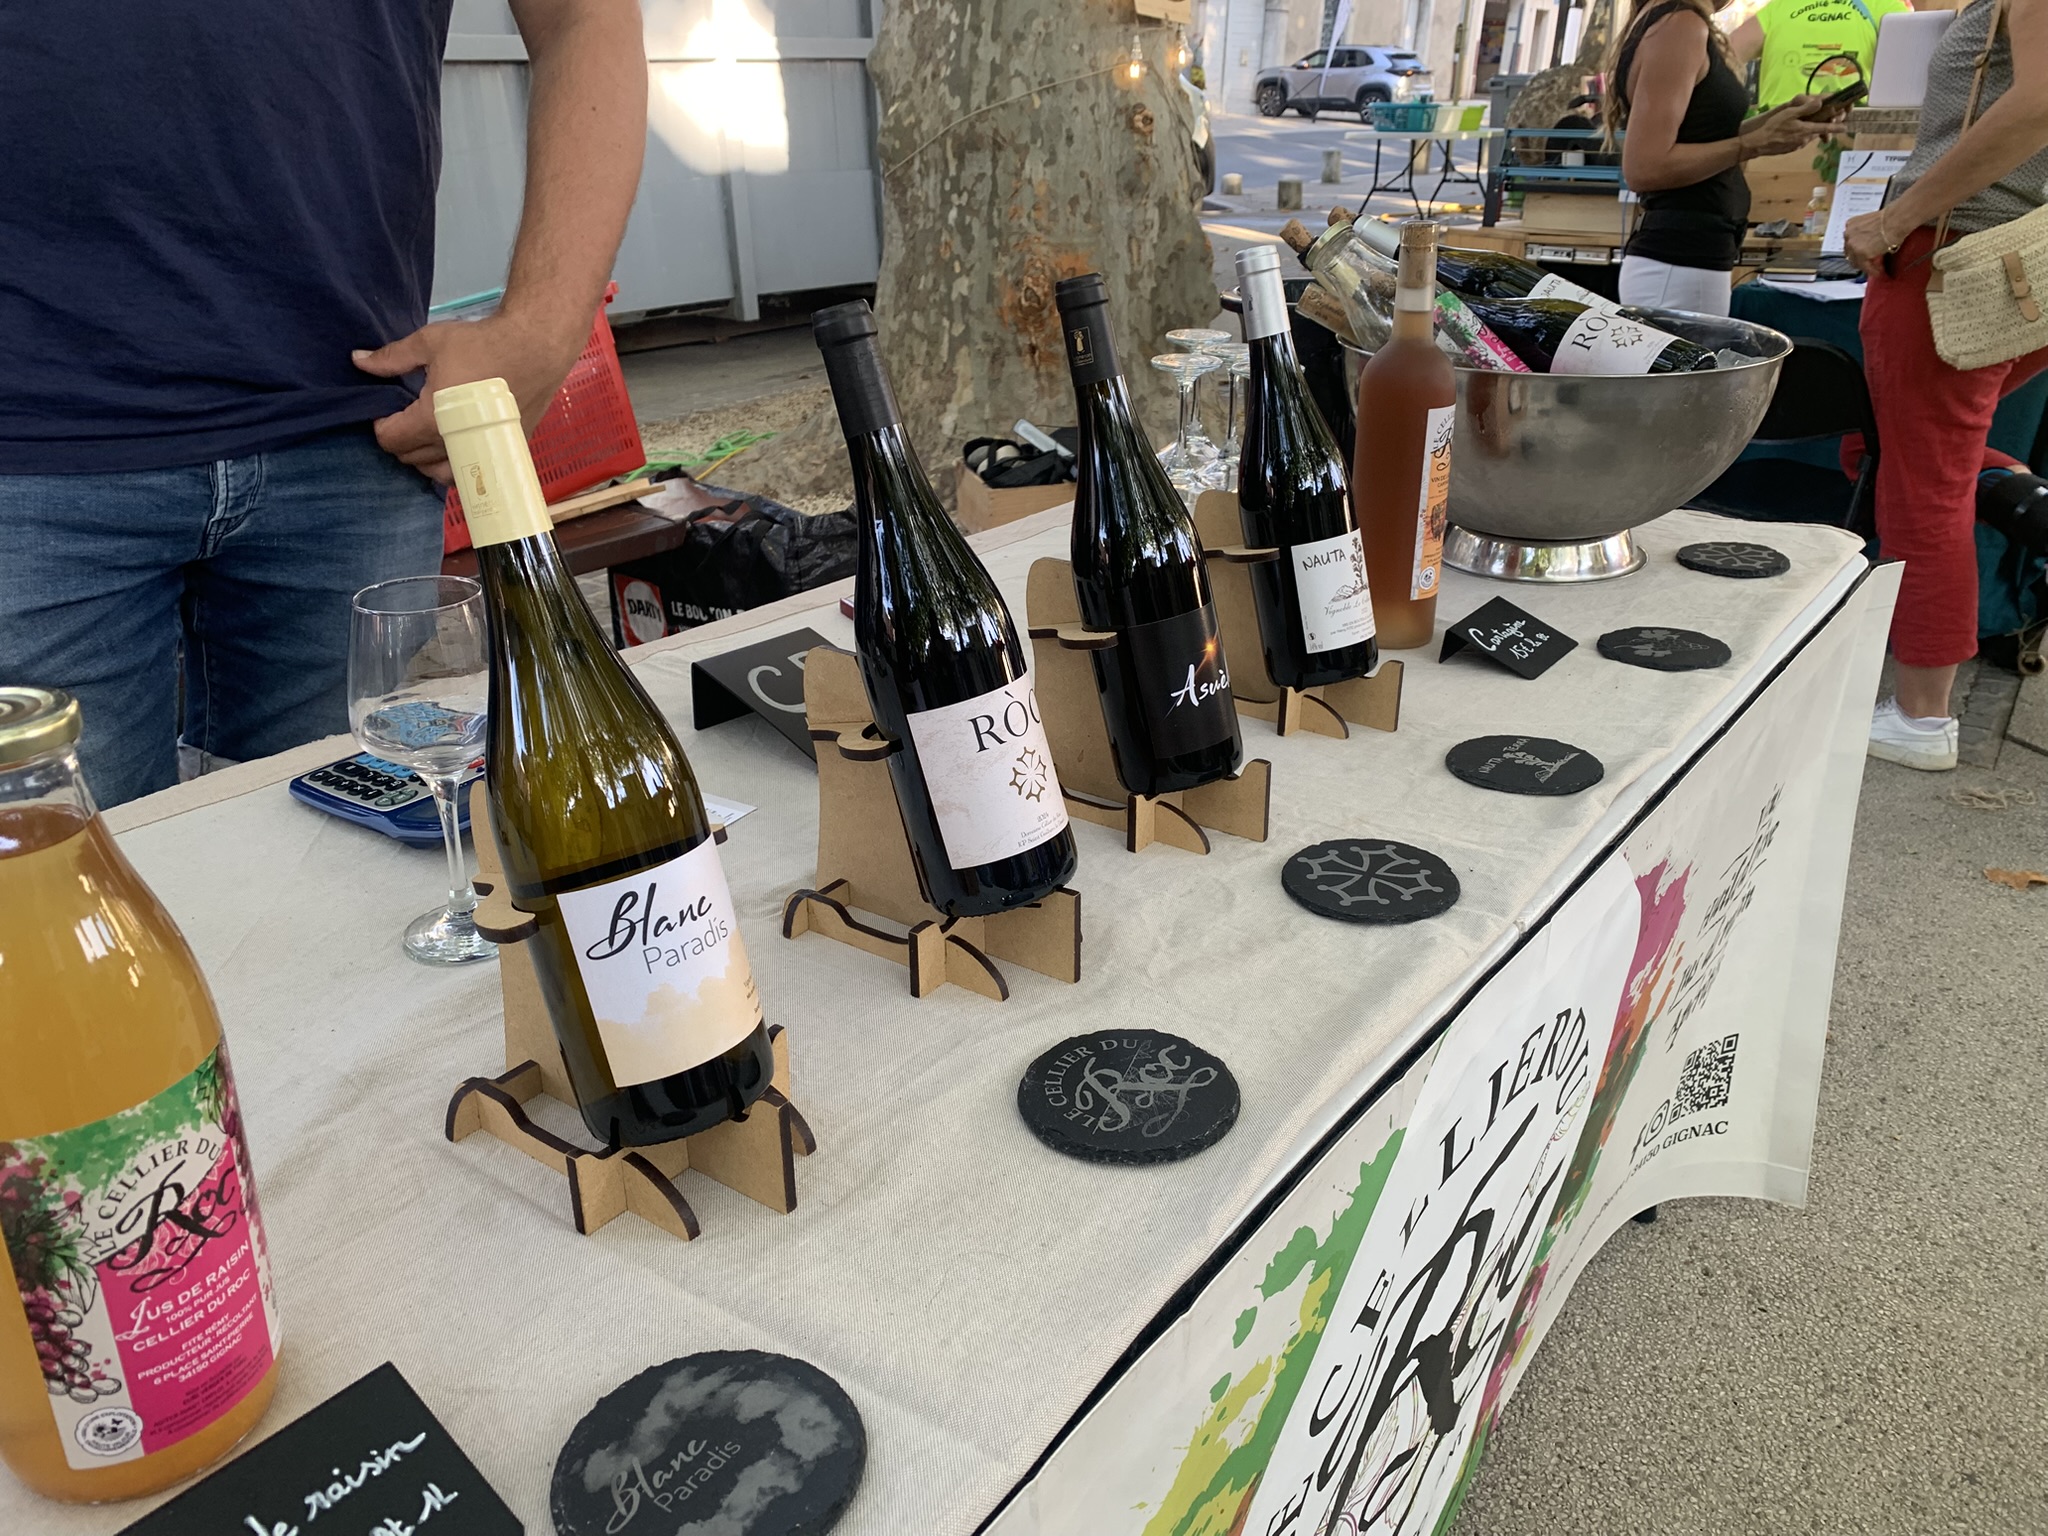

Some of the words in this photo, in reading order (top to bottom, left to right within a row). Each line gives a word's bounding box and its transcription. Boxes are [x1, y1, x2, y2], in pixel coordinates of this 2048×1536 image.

[1808, 12, 1851, 21] GIGNAC
[1302, 549, 1346, 571] NAUTA
[628, 599, 662, 623] DARTY
[671, 601, 684, 617] LE
[586, 883, 713, 960] Blanc
[642, 917, 729, 974] Paradis
[1099, 1038, 1139, 1051] DU
[1044, 1045, 1095, 1107] CELLIER
[1063, 1107, 1096, 1129] LE
[1662, 1121, 1729, 1150] GIGNAC
[195, 1137, 221, 1161] DU
[97, 1139, 189, 1220] CELLIER
[94, 1227, 118, 1256] LE
[177, 1282, 203, 1306] DE
[205, 1240, 249, 1287] RAISIN
[132, 1311, 205, 1352] CELLIER
[207, 1292, 226, 1314] DU
[227, 1268, 251, 1297] ROC
[166, 1306, 192, 1324] 100%
[194, 1289, 214, 1307] PUR
[213, 1276, 230, 1293] JUS
[137, 1336, 213, 1380] PRODUCTEUR
[178, 1361, 209, 1383] 34150
[210, 1333, 243, 1363] GIGNAC
[181, 1331, 204, 1351] FITE
[154, 1376, 162, 1385] 6
[163, 1358, 200, 1382] PLACE
[304, 1432, 427, 1521] raisin
[605, 1439, 708, 1534] Blanc
[653, 1441, 742, 1513] Paradis
